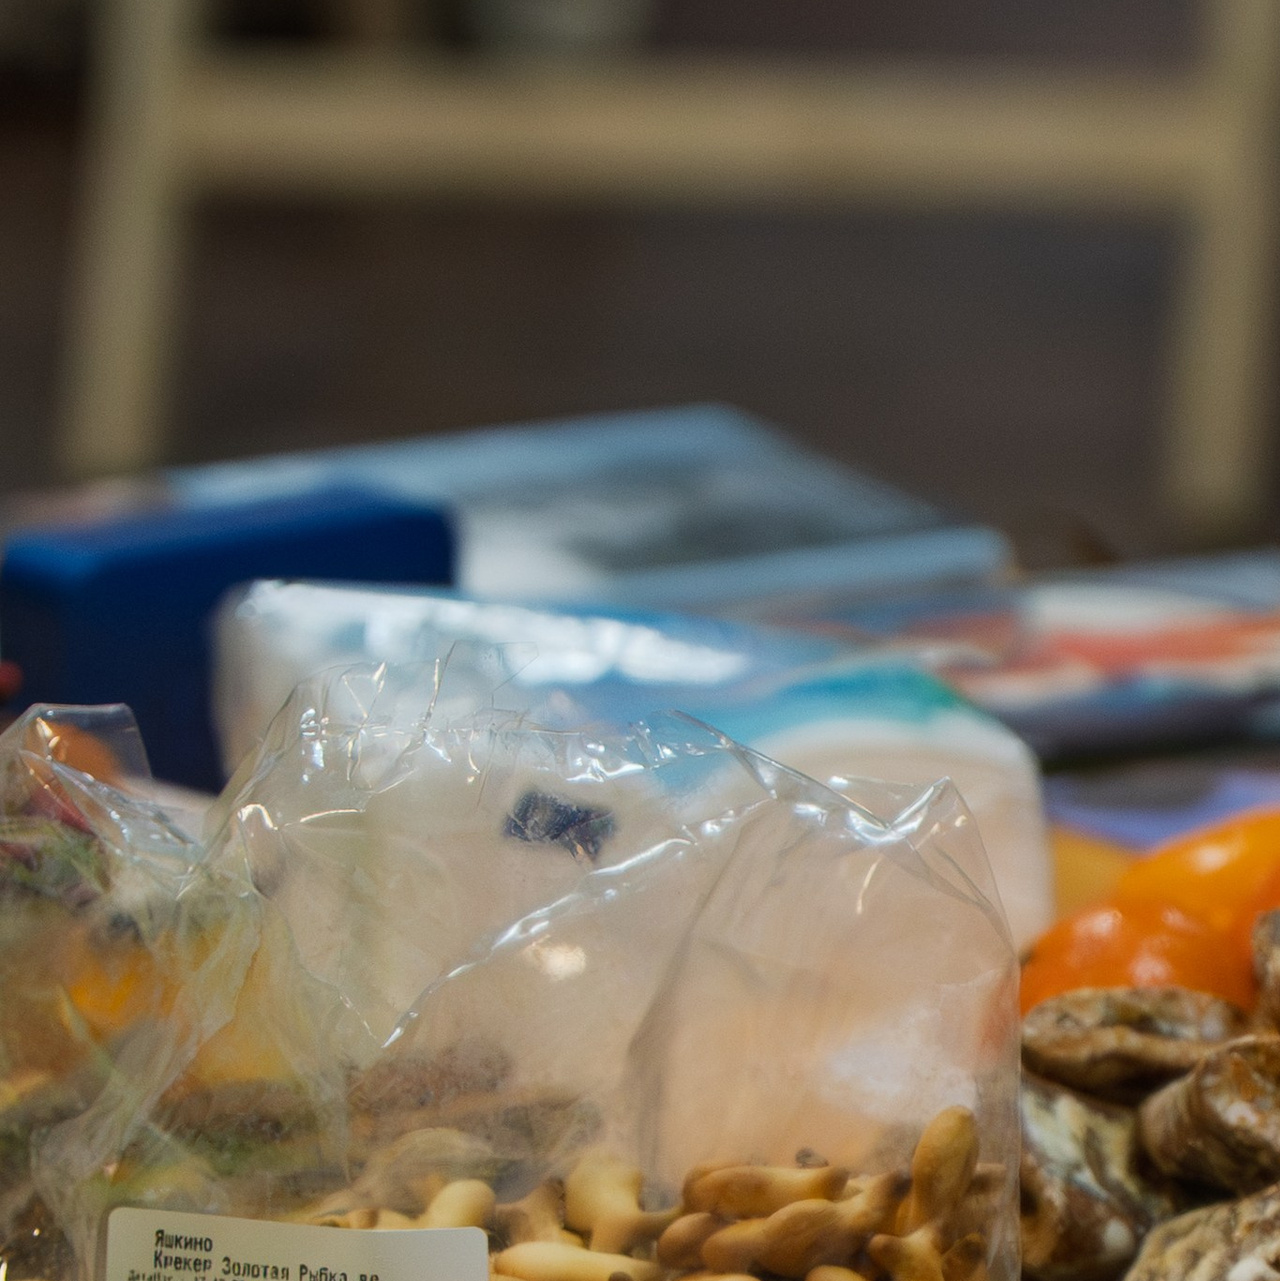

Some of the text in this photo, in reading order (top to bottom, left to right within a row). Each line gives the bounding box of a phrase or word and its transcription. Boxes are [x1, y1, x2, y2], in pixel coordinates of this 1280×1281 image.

[155, 1229, 213, 1252] Яшкино
[153, 1250, 212, 1273] Крекер
[221, 1257, 290, 1281] Золотая
